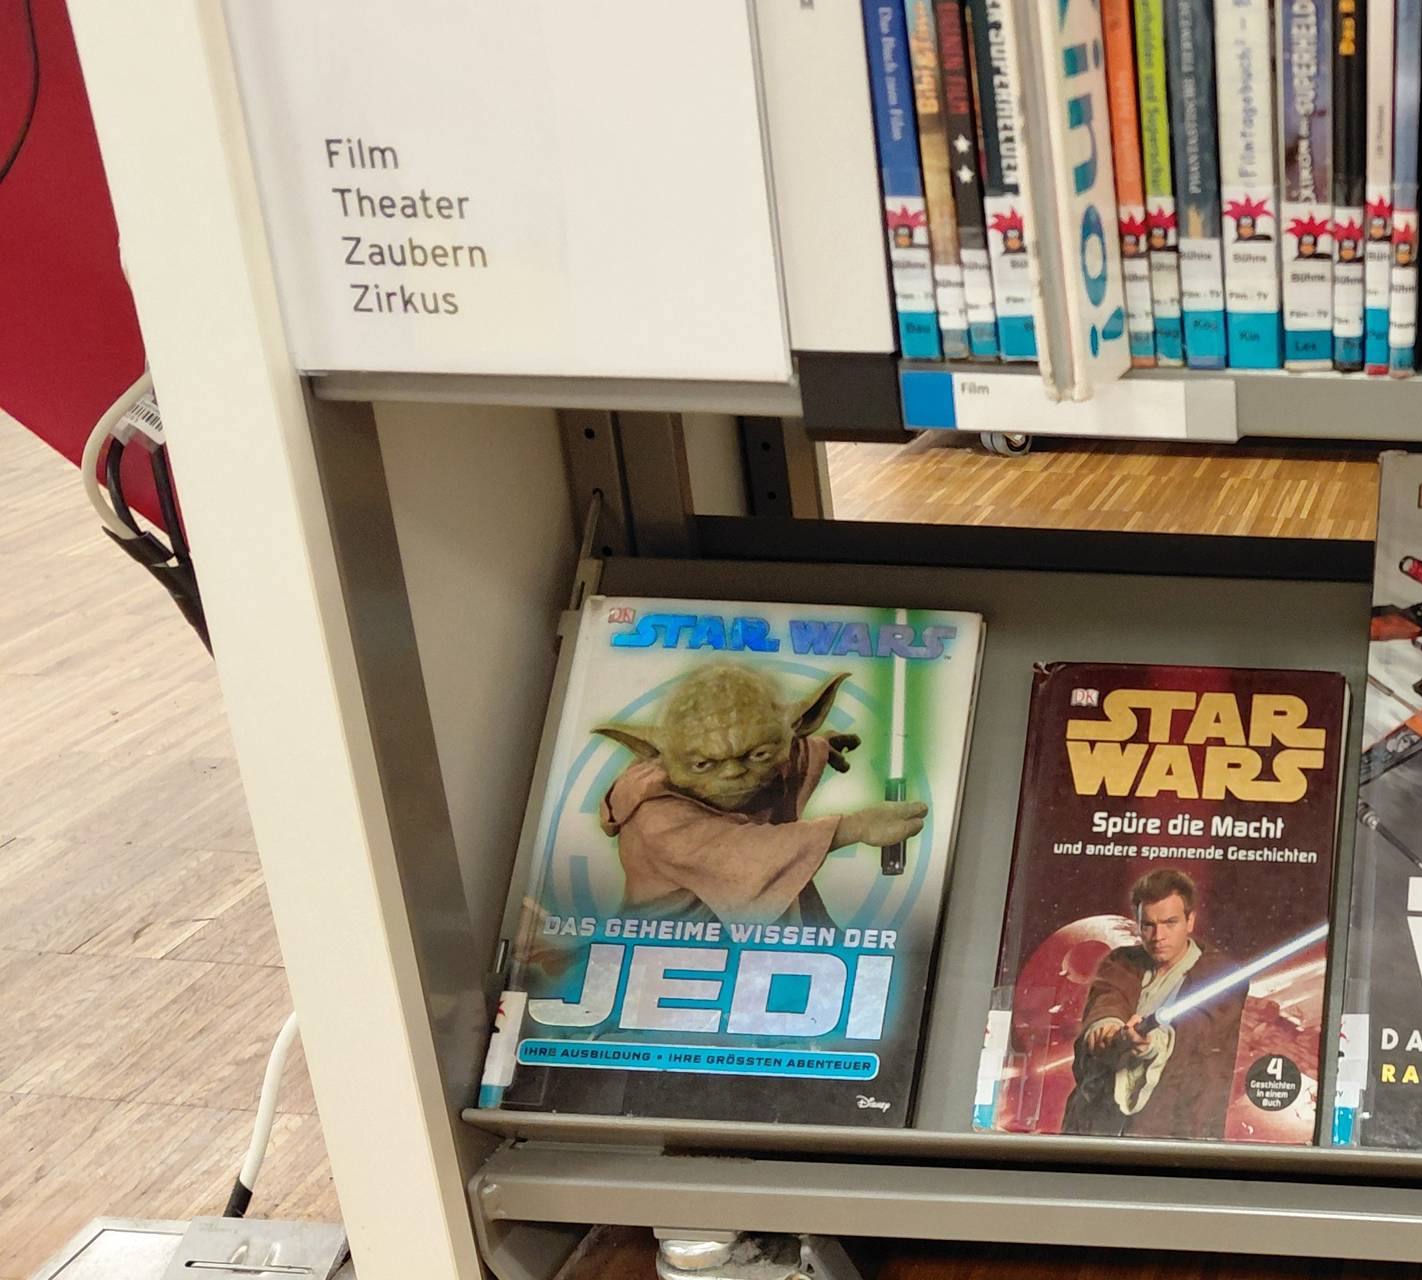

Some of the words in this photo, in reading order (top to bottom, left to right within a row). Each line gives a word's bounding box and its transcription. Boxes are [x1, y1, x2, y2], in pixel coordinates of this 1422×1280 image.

[325, 138, 399, 169] Film
[1060, 0, 1124, 358] ino!
[331, 187, 470, 219] Theater
[341, 236, 488, 268] Zaubern
[350, 284, 459, 315] Zirkus
[960, 381, 990, 396] Film
[610, 612, 780, 653] STAR
[788, 619, 957, 660] WARS
[1071, 688, 1099, 707] DK
[1065, 688, 1327, 750] STAR
[1065, 740, 1325, 804] WARS
[1092, 811, 1161, 838] Spüre
[1168, 813, 1204, 836] die
[1211, 815, 1286, 840] Macht
[1053, 841, 1083, 856] und
[1086, 843, 1138, 858] andere
[1140, 845, 1224, 862] spannende
[1227, 846, 1318, 864] Geschichten
[543, 916, 597, 938] DAS
[605, 918, 721, 942] GEHEIME
[730, 924, 836, 948] WISSEN
[844, 929, 899, 950] DER
[527, 943, 895, 1041] JEDI
[524, 1046, 557, 1058] IHRE
[560, 1048, 651, 1062] AUSBILDUNG
[668, 1053, 702, 1064] IHRE
[706, 1053, 783, 1068] GRÖSSTEN
[786, 1058, 872, 1072] ABENTEUER
[1266, 1057, 1283, 1081] 4
[1250, 1080, 1296, 1090] Geschichten
[1265, 1090, 1289, 1099] einem
[856, 1094, 892, 1114] Disney
[1262, 1098, 1282, 1107] Buch
